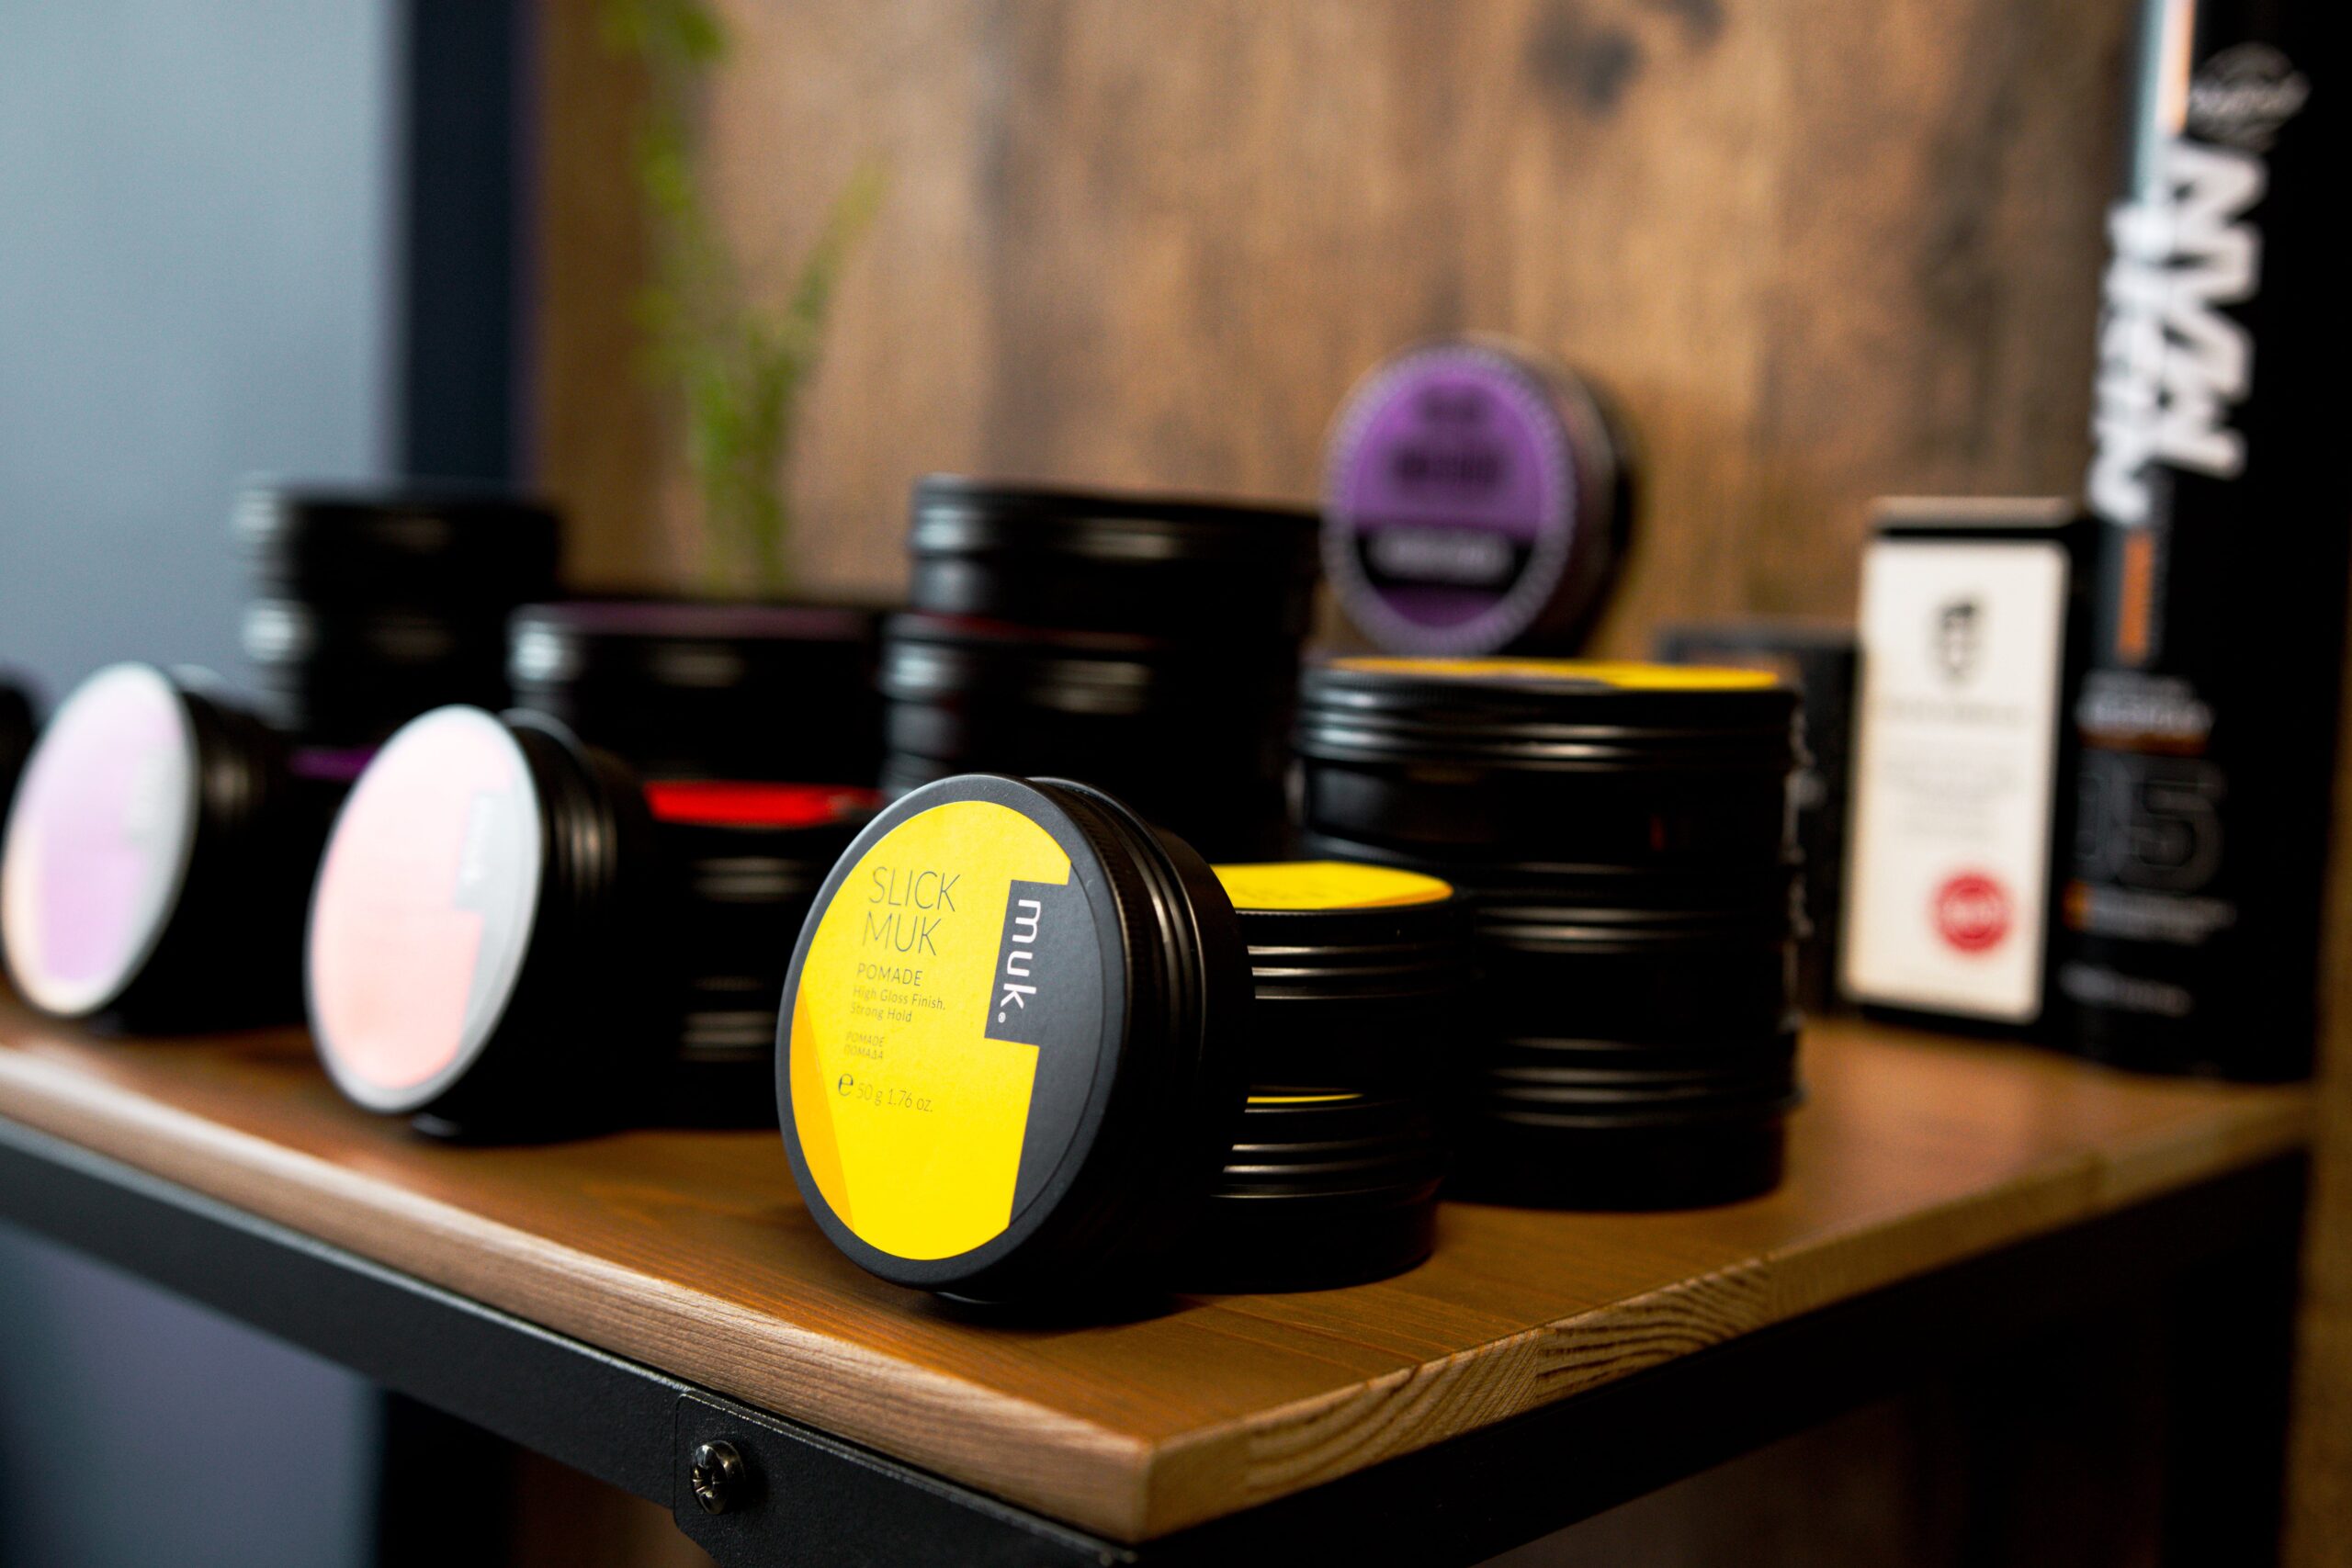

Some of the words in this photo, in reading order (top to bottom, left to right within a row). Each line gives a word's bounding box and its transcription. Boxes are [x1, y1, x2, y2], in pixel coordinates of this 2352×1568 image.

[869, 866, 960, 912] SLICK
[863, 910, 942, 956] MUK
[856, 963, 923, 987] POMADE
[850, 1002, 883, 1021] Strong
[887, 1009, 912, 1022] Hold
[854, 987, 876, 1001] High
[880, 989, 909, 1005] Gloss
[911, 993, 945, 1011] Finish.
[855, 1082, 874, 1100] 50
[874, 1090, 883, 1107] g
[888, 1089, 912, 1109] 1.76
[916, 1099, 933, 1112] oz.
